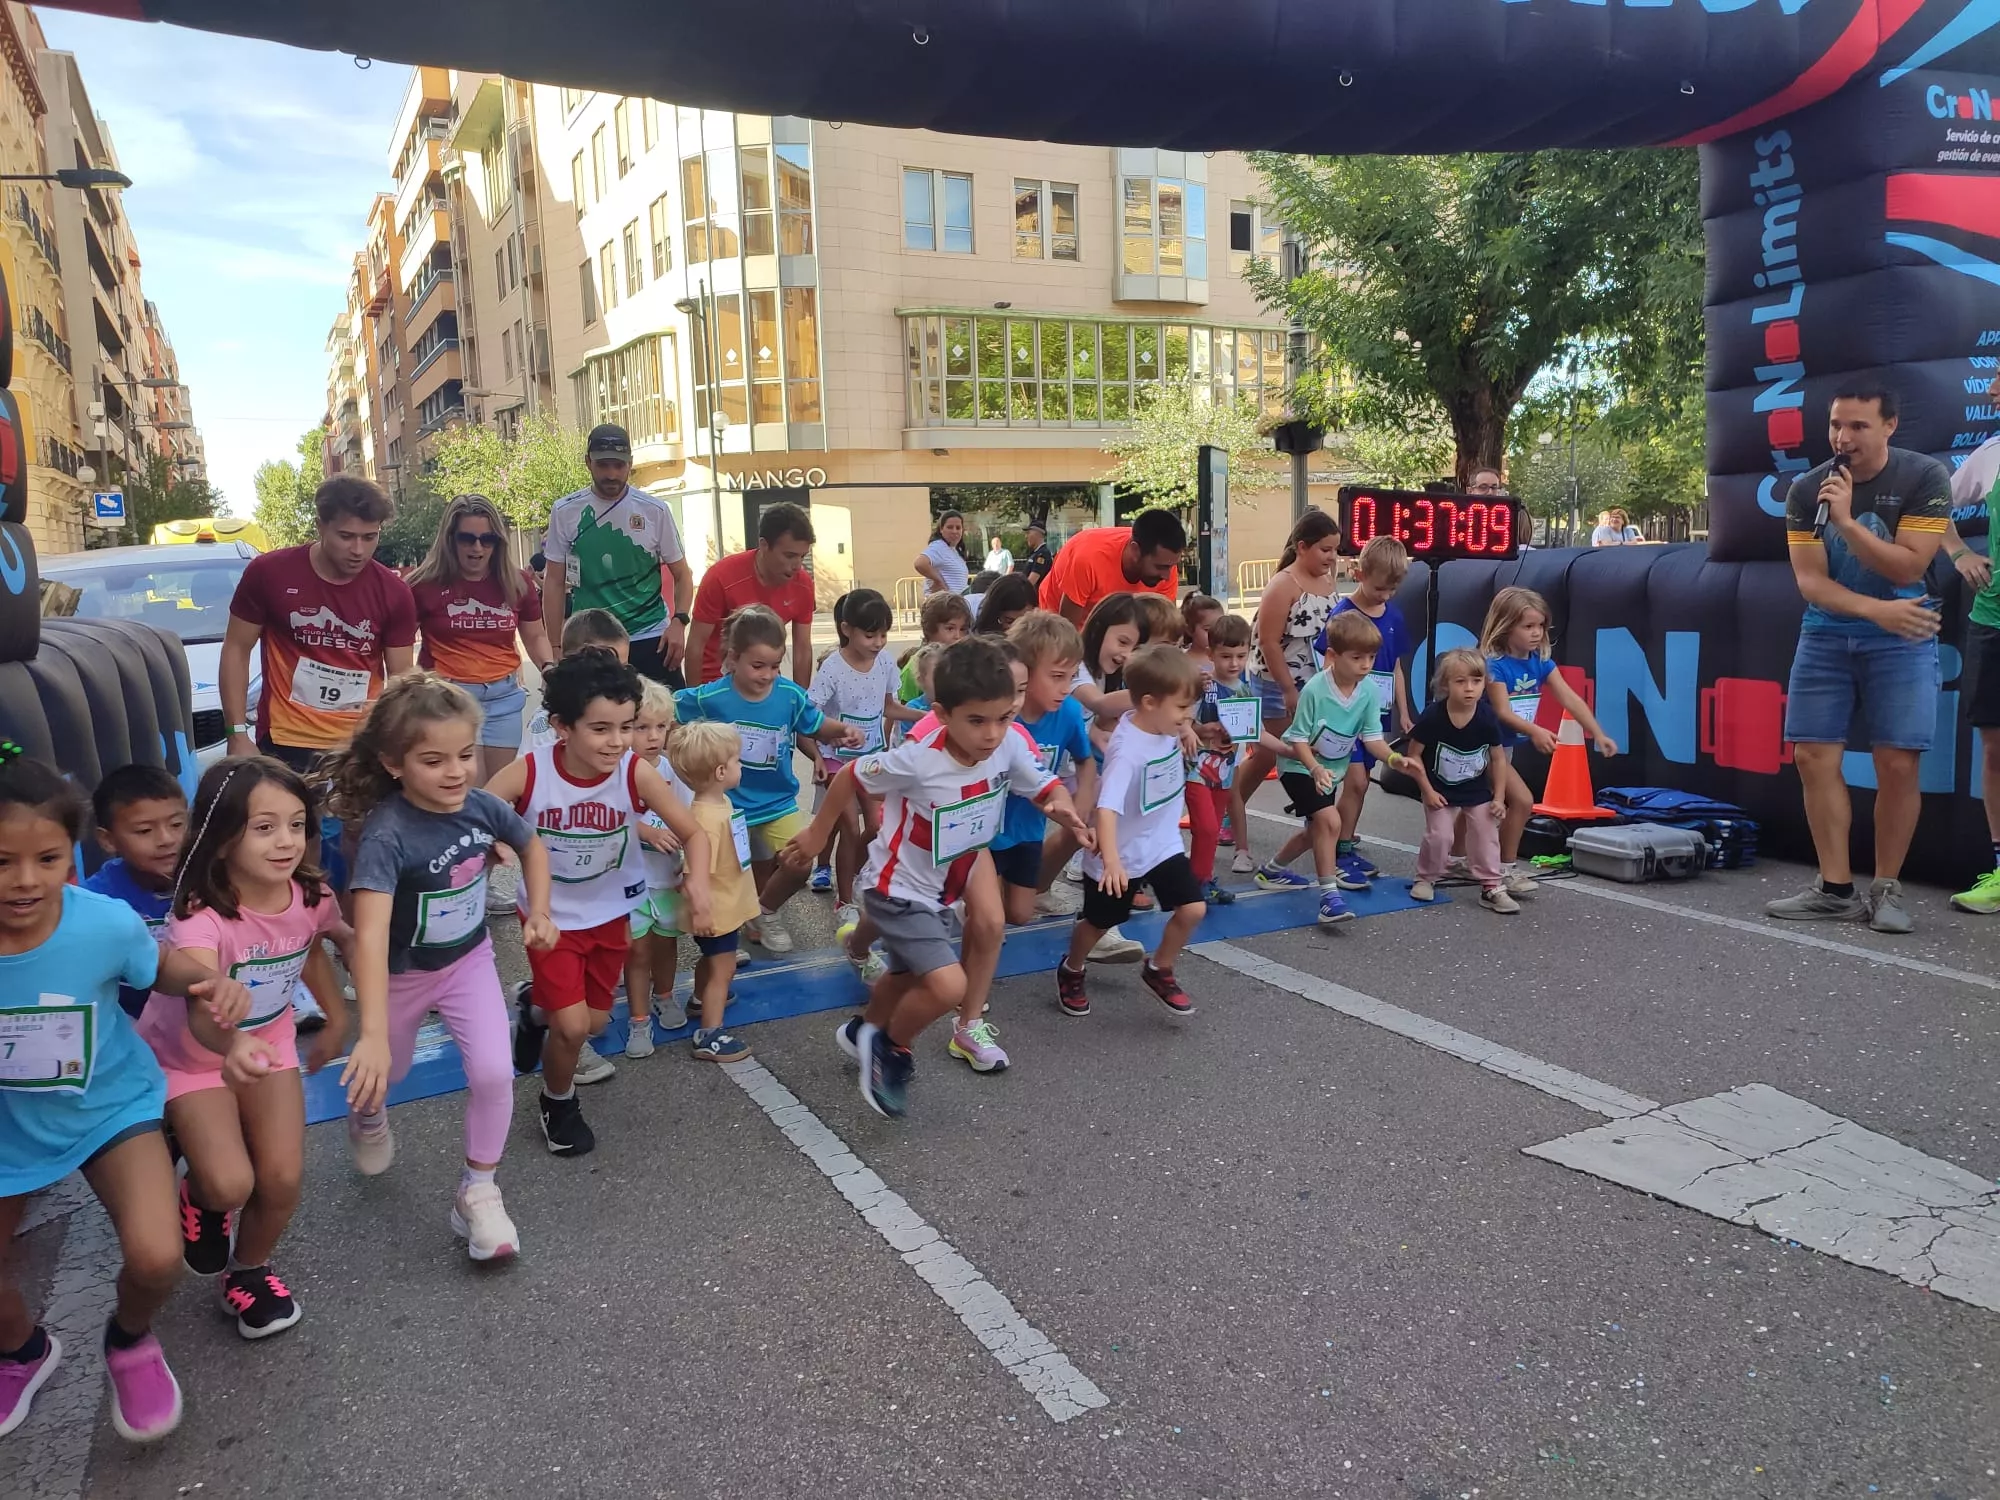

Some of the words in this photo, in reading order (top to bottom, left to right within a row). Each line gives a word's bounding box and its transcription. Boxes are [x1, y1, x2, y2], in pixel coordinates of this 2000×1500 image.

[1946, 128, 1979, 143] Servicio
[1979, 130, 1992, 143] de
[1937, 148, 1970, 162] gestión
[1970, 149, 1982, 161] de
[726, 467, 827, 490] MANGO
[1353, 496, 1510, 552] 01:37:09
[451, 620, 515, 629] HUESCA
[294, 633, 372, 652] HUESCA
[319, 686, 341, 702] 19
[747, 741, 754, 751] 3
[538, 808, 562, 831] AIR
[563, 802, 627, 832] JORDAN
[650, 818, 663, 830] 28
[970, 820, 984, 835] 24
[429, 844, 460, 873] Care
[575, 855, 592, 866] 20
[3, 1042, 16, 1060] 7
